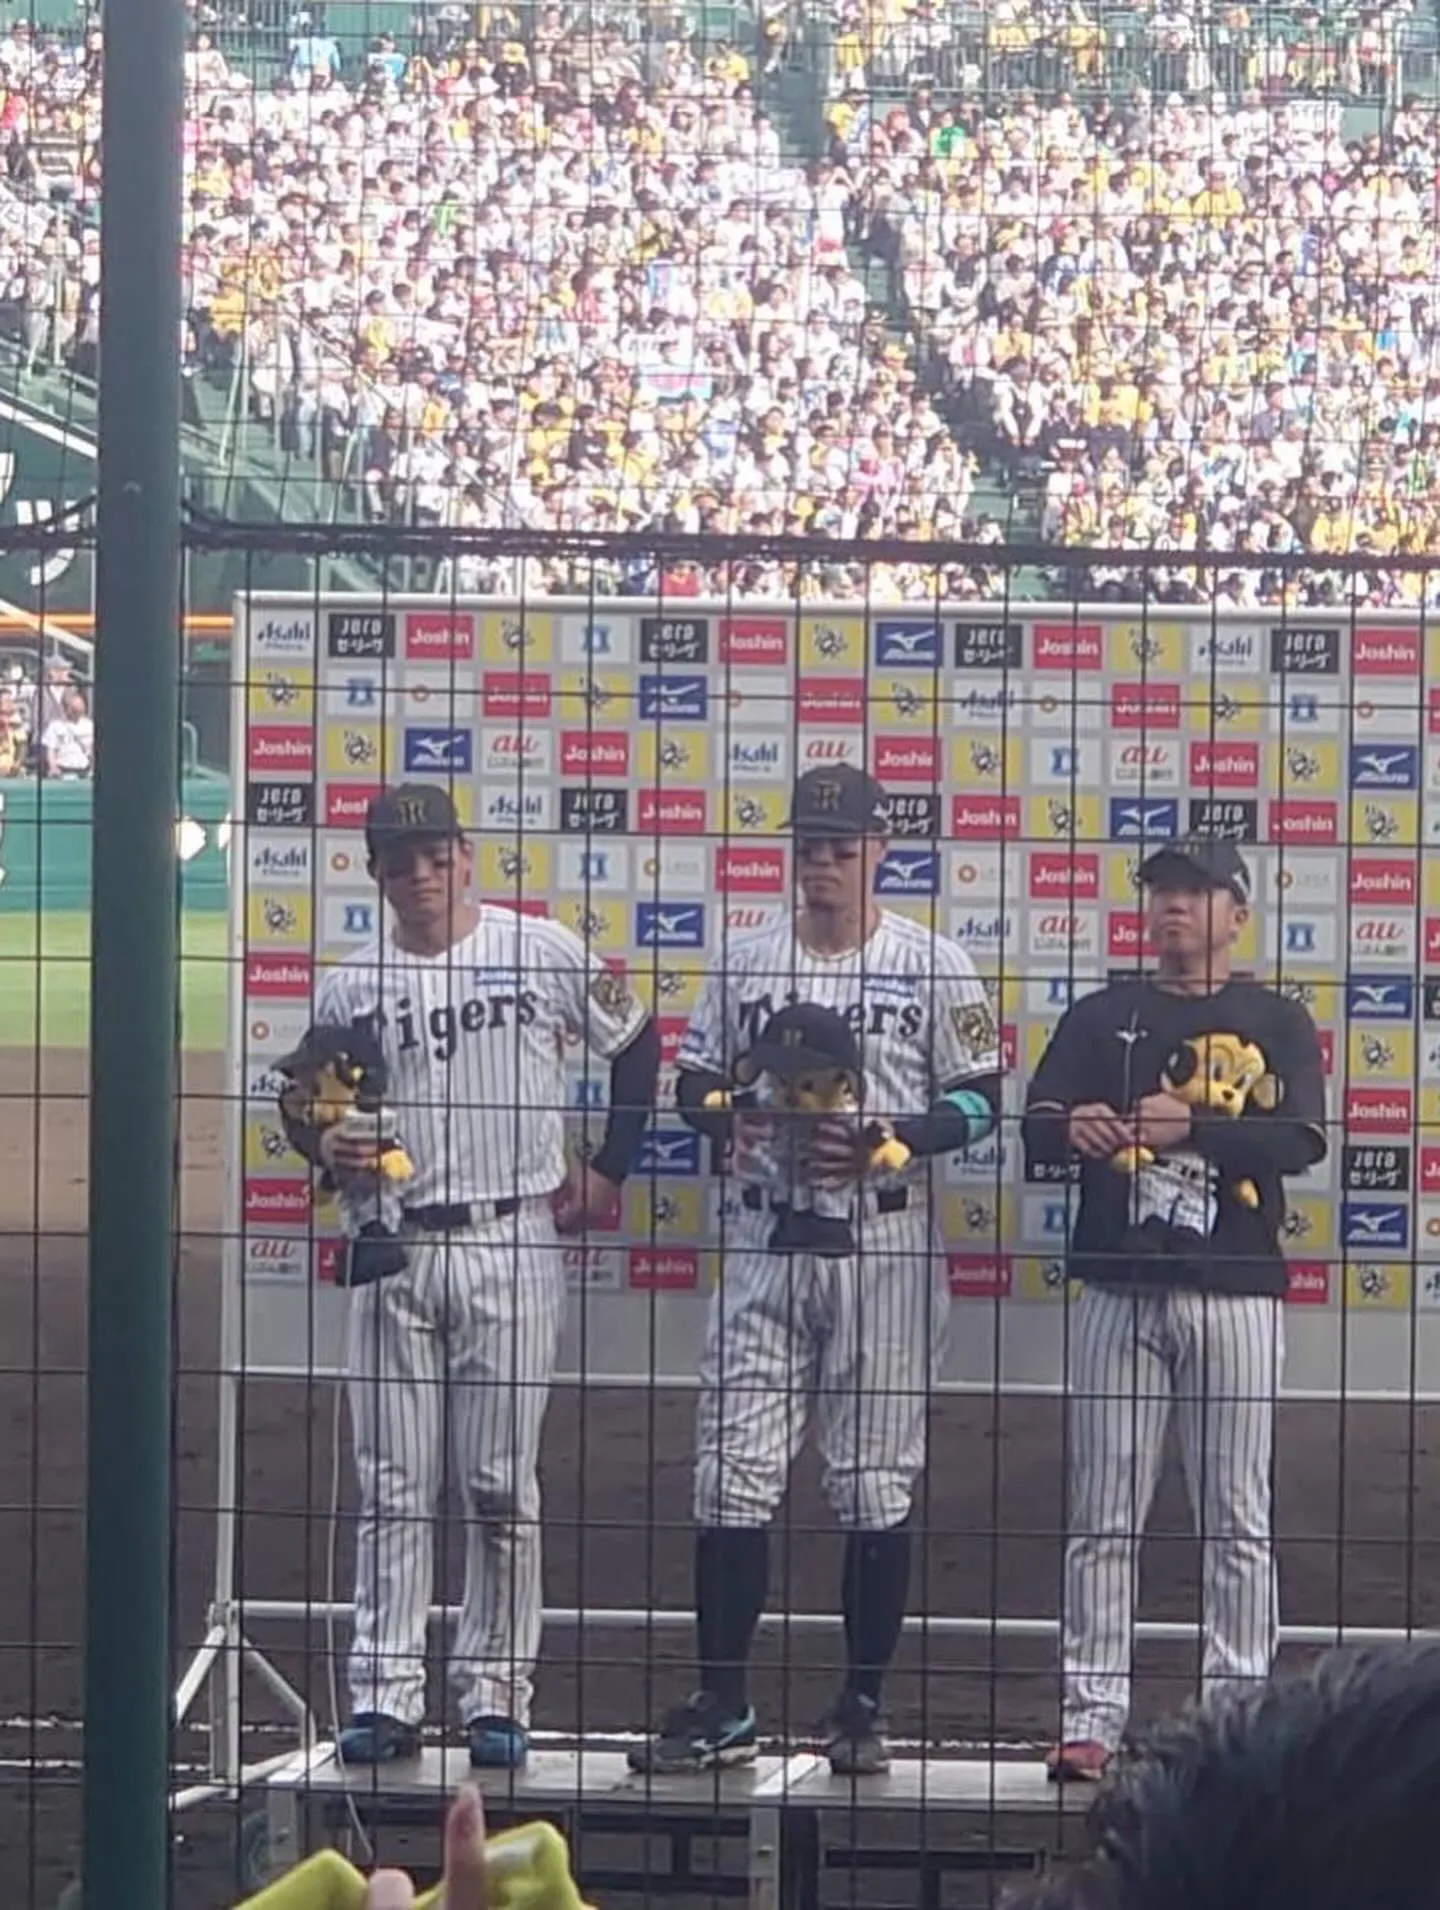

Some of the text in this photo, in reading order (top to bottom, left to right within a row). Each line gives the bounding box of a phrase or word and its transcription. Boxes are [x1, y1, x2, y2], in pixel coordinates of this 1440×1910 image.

[1354, 644, 1415, 661] Joshin
[253, 739, 312, 756] Joshin
[806, 740, 852, 759] au
[1272, 815, 1333, 832] oshin
[1352, 872, 1412, 890] Joshin
[727, 908, 772, 929] au
[1356, 922, 1404, 940] au
[250, 966, 310, 983] Joshin
[1348, 1102, 1407, 1120] Joshin
